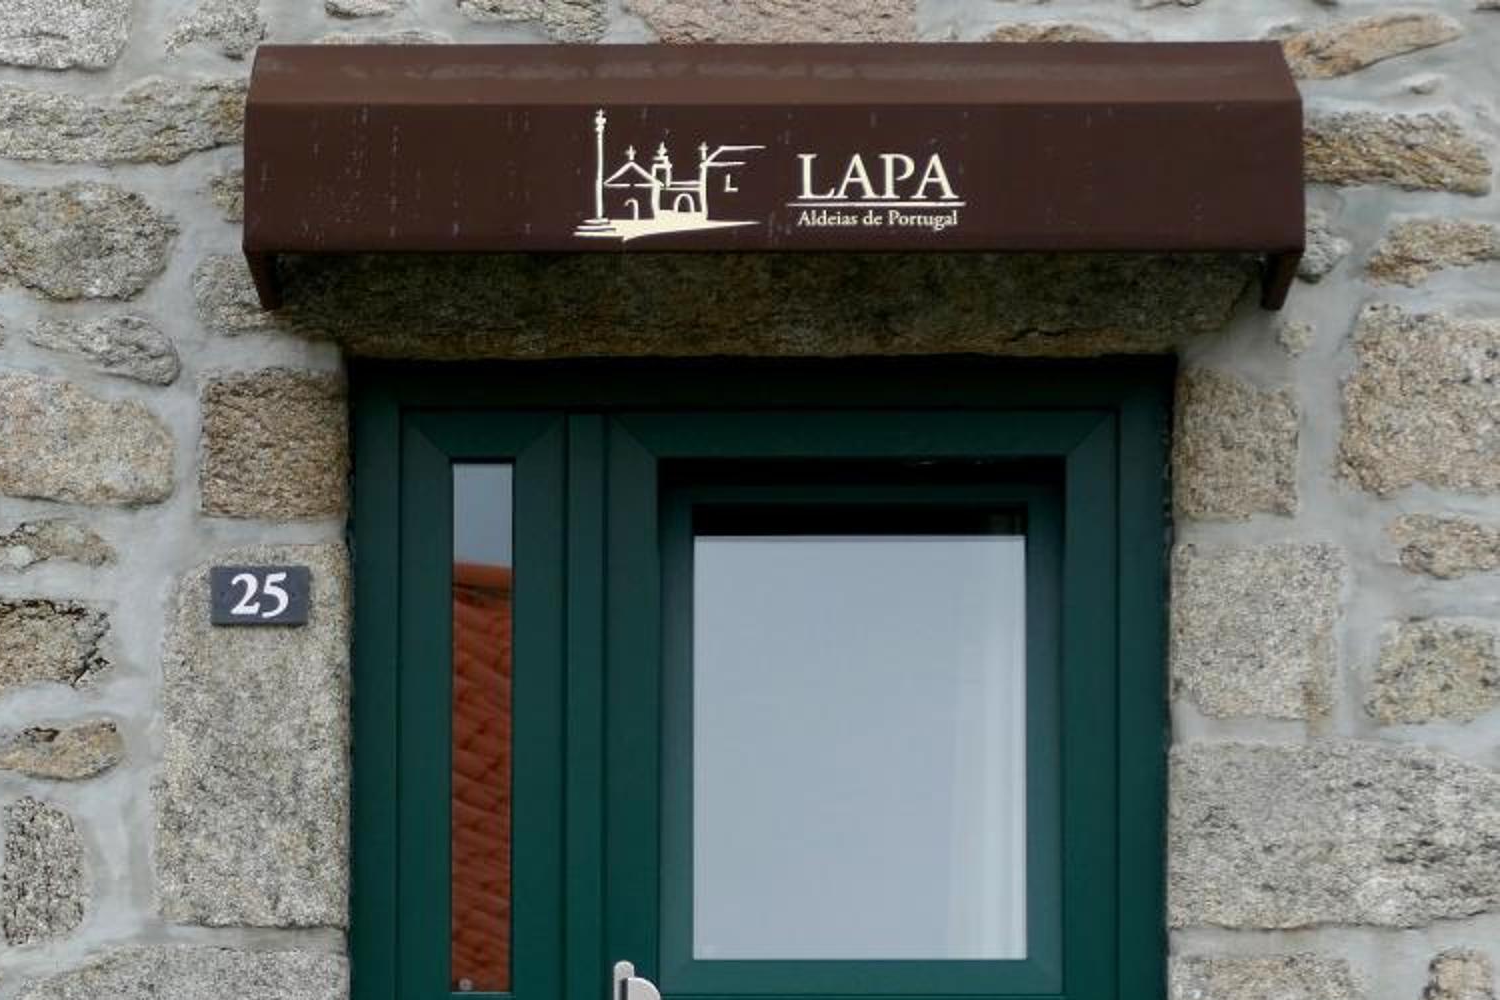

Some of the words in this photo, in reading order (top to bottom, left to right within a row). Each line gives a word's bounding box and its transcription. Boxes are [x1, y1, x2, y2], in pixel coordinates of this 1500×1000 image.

[797, 153, 960, 200] LAPA
[797, 210, 858, 226] Aldeias
[862, 210, 883, 226] de
[888, 210, 958, 231] Portugal
[230, 572, 289, 618] 25
